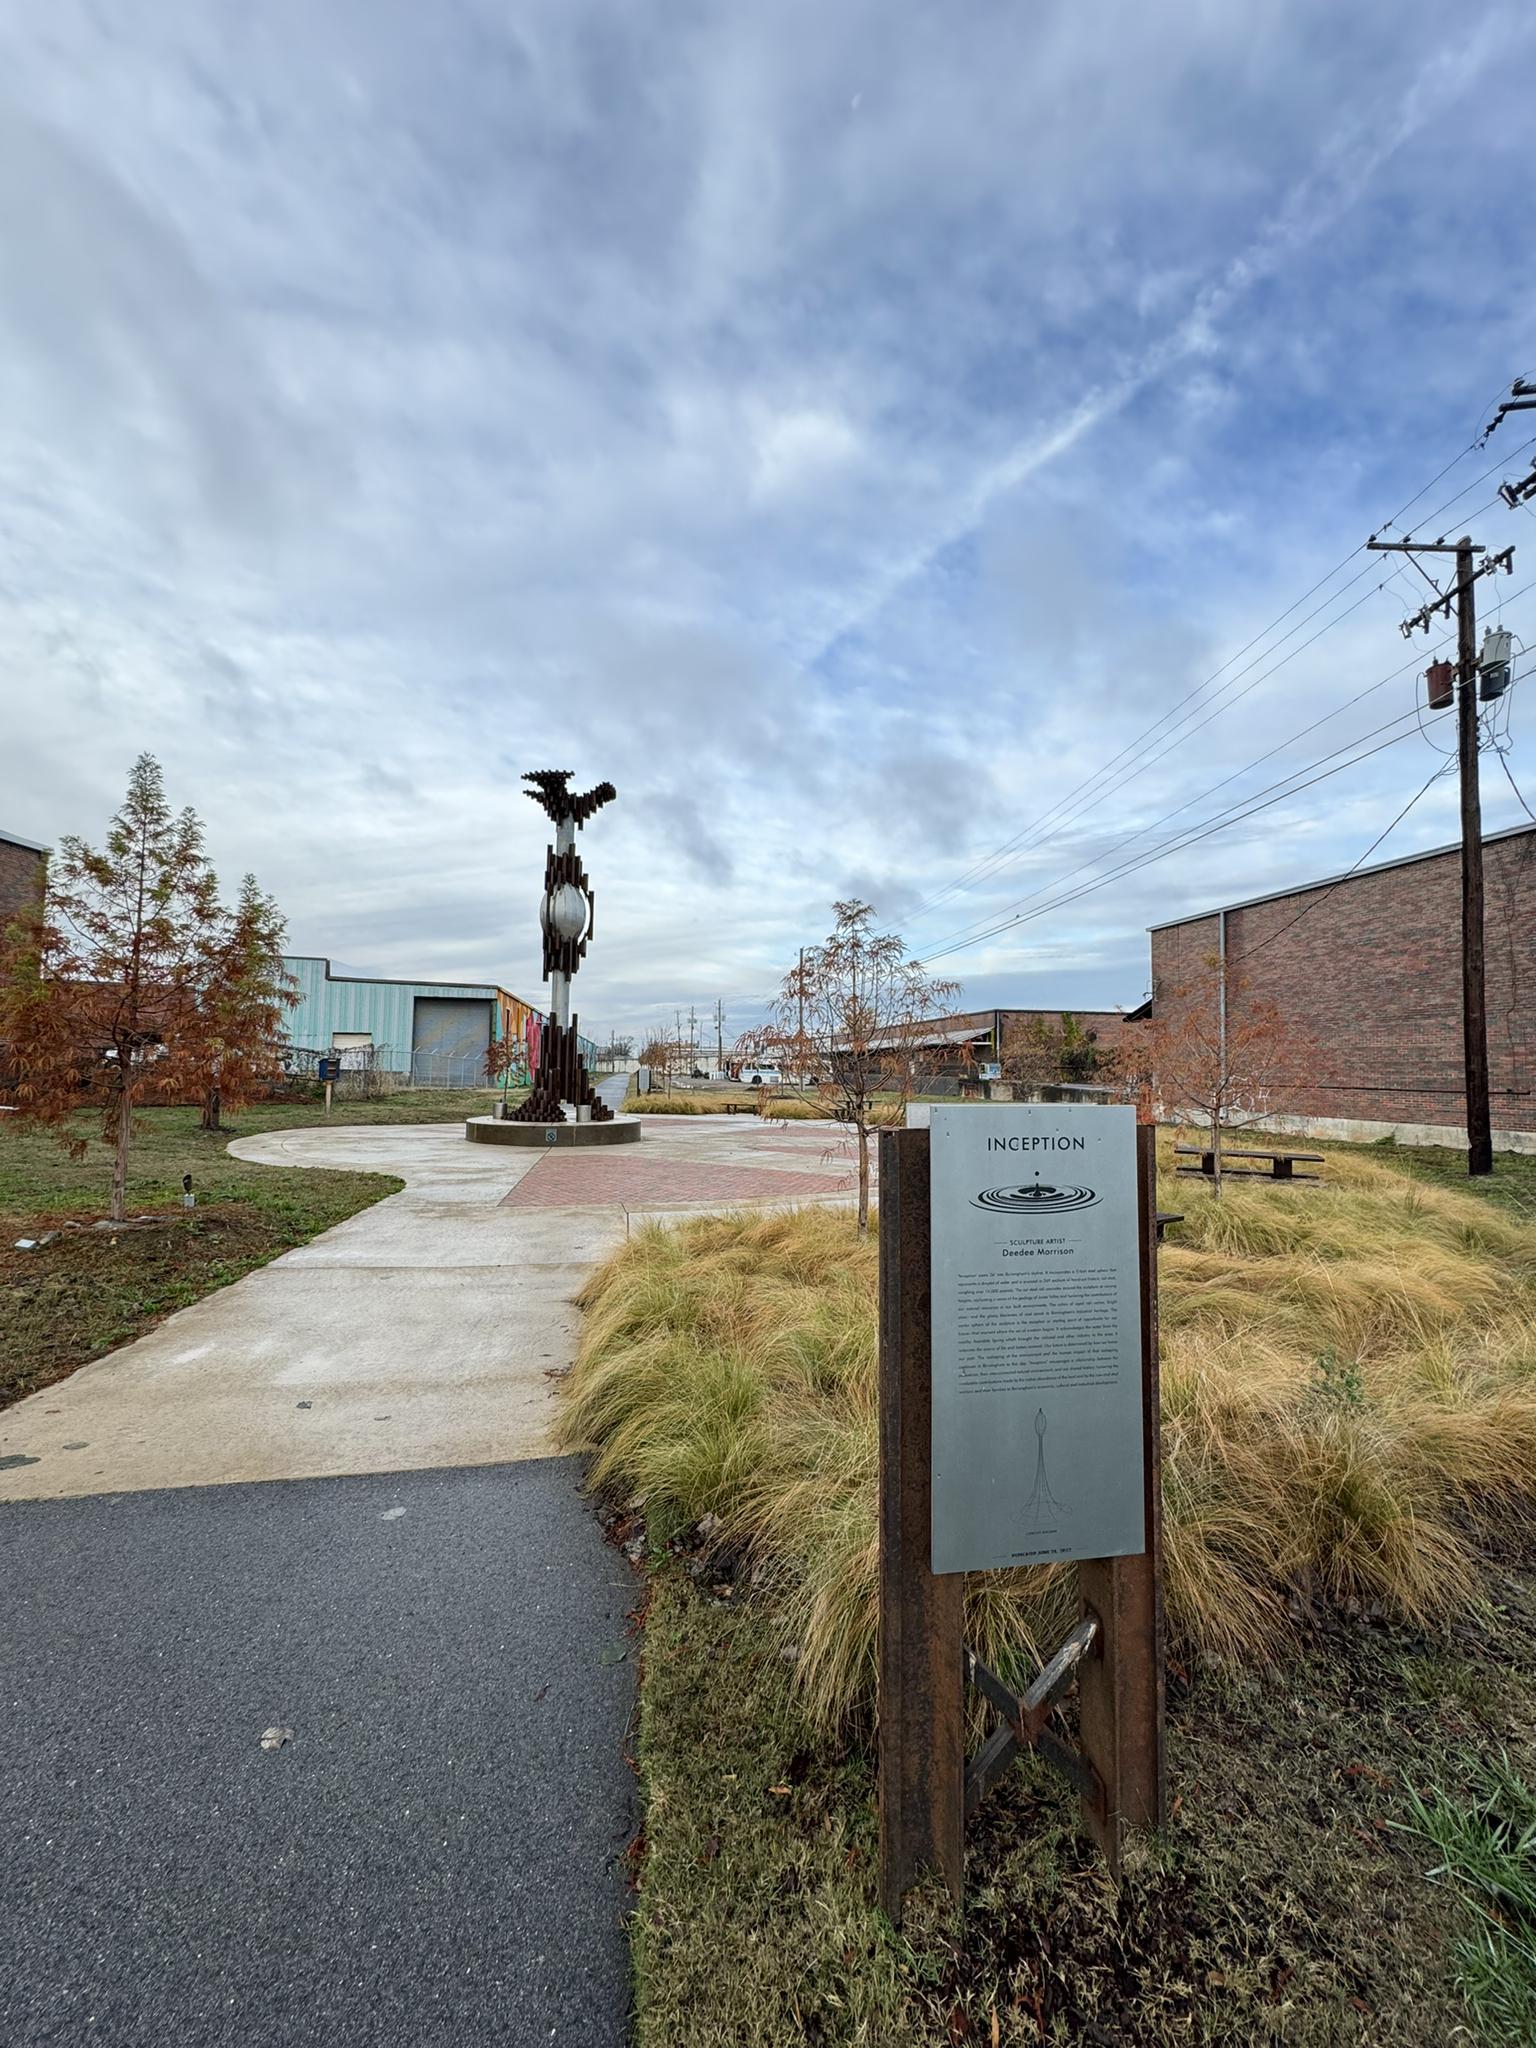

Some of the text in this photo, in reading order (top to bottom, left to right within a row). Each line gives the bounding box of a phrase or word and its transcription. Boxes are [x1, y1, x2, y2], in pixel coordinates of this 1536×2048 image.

[987, 1136, 1085, 1151] INCEPTION
[1002, 1248, 1074, 1257] Deedee Morrison
